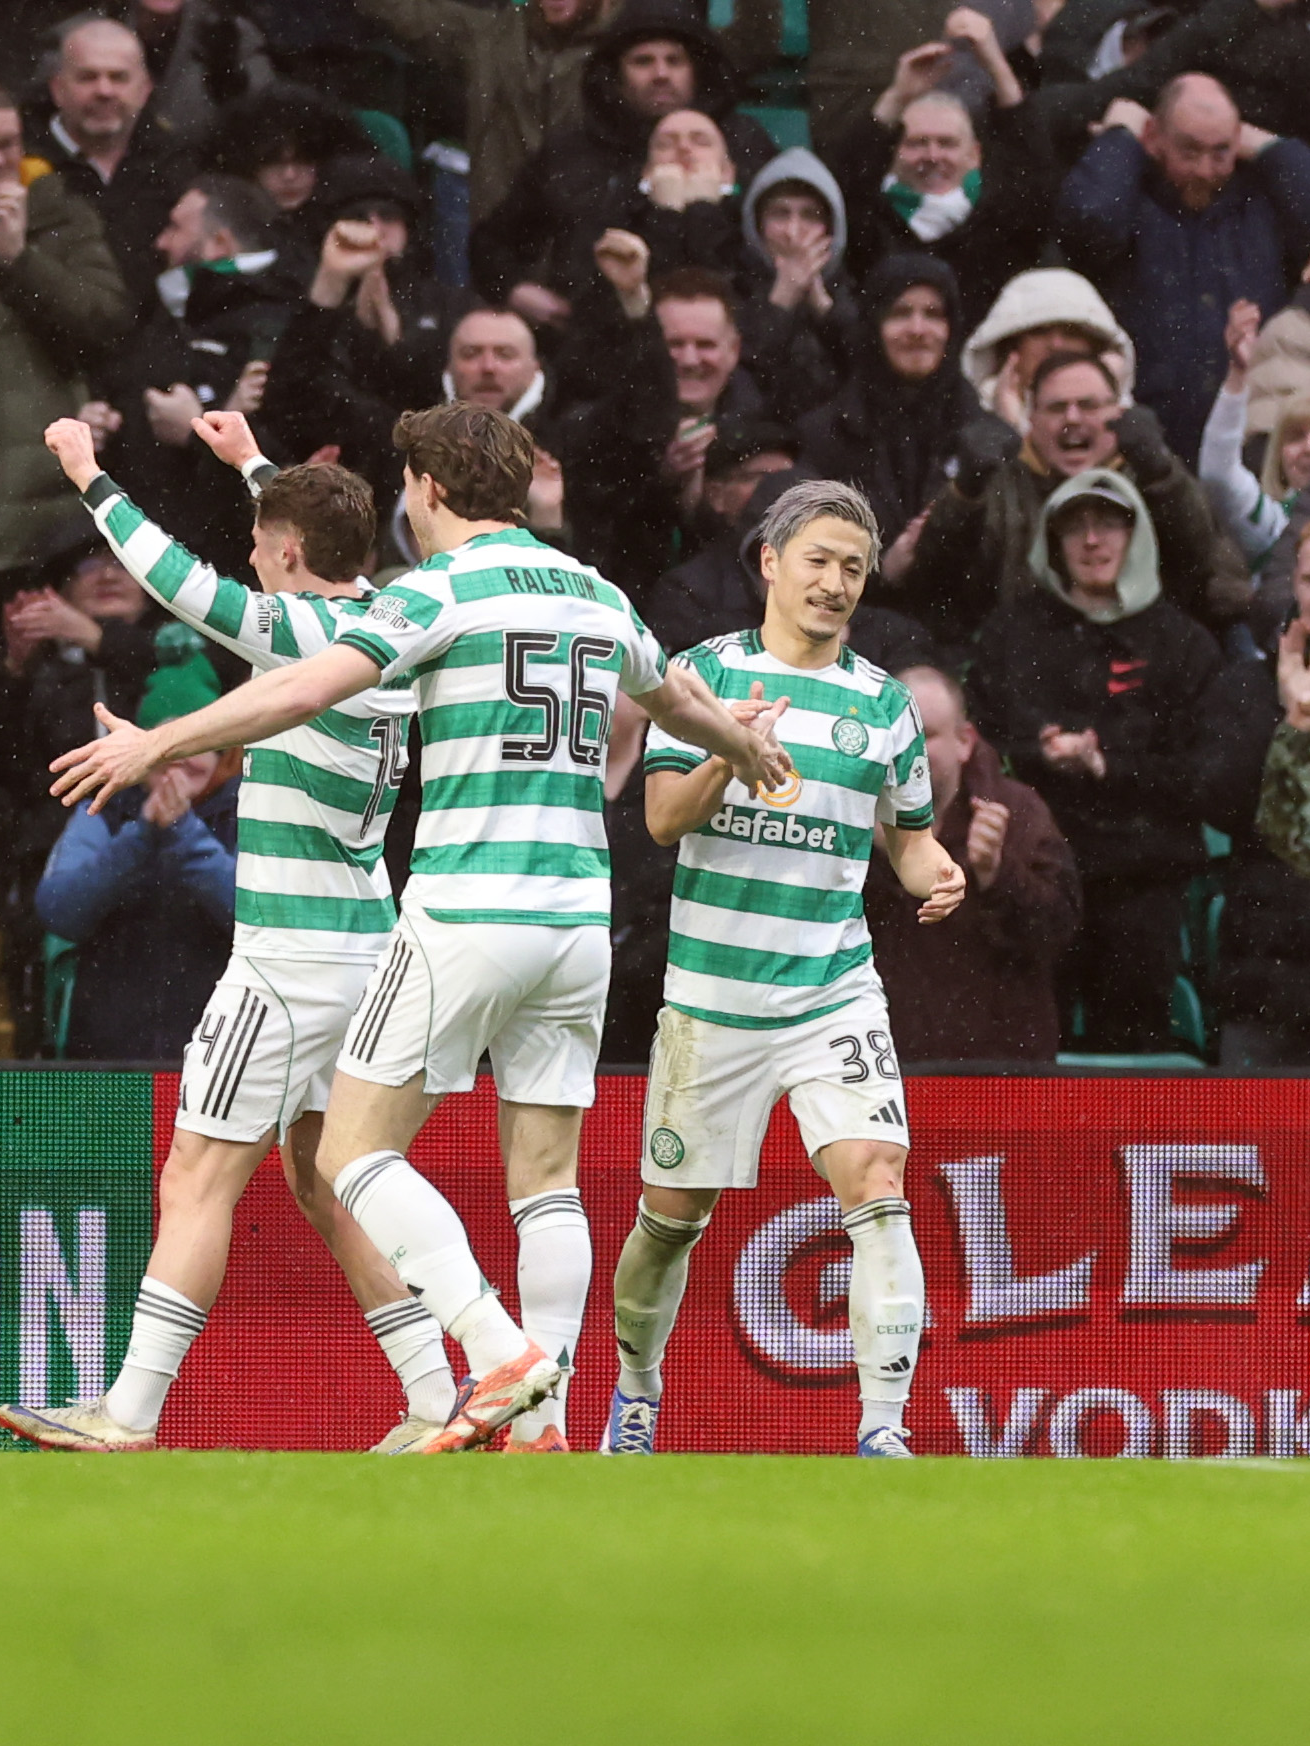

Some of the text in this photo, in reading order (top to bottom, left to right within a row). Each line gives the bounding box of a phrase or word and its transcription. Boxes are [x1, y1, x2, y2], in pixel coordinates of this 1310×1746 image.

[504, 568, 599, 602] RALSTON
[501, 629, 617, 768] 56
[710, 805, 837, 851] dafabet
[829, 1030, 899, 1083] 38
[732, 1144, 1310, 1368] GLE
[876, 1322, 918, 1335] CELTIC
